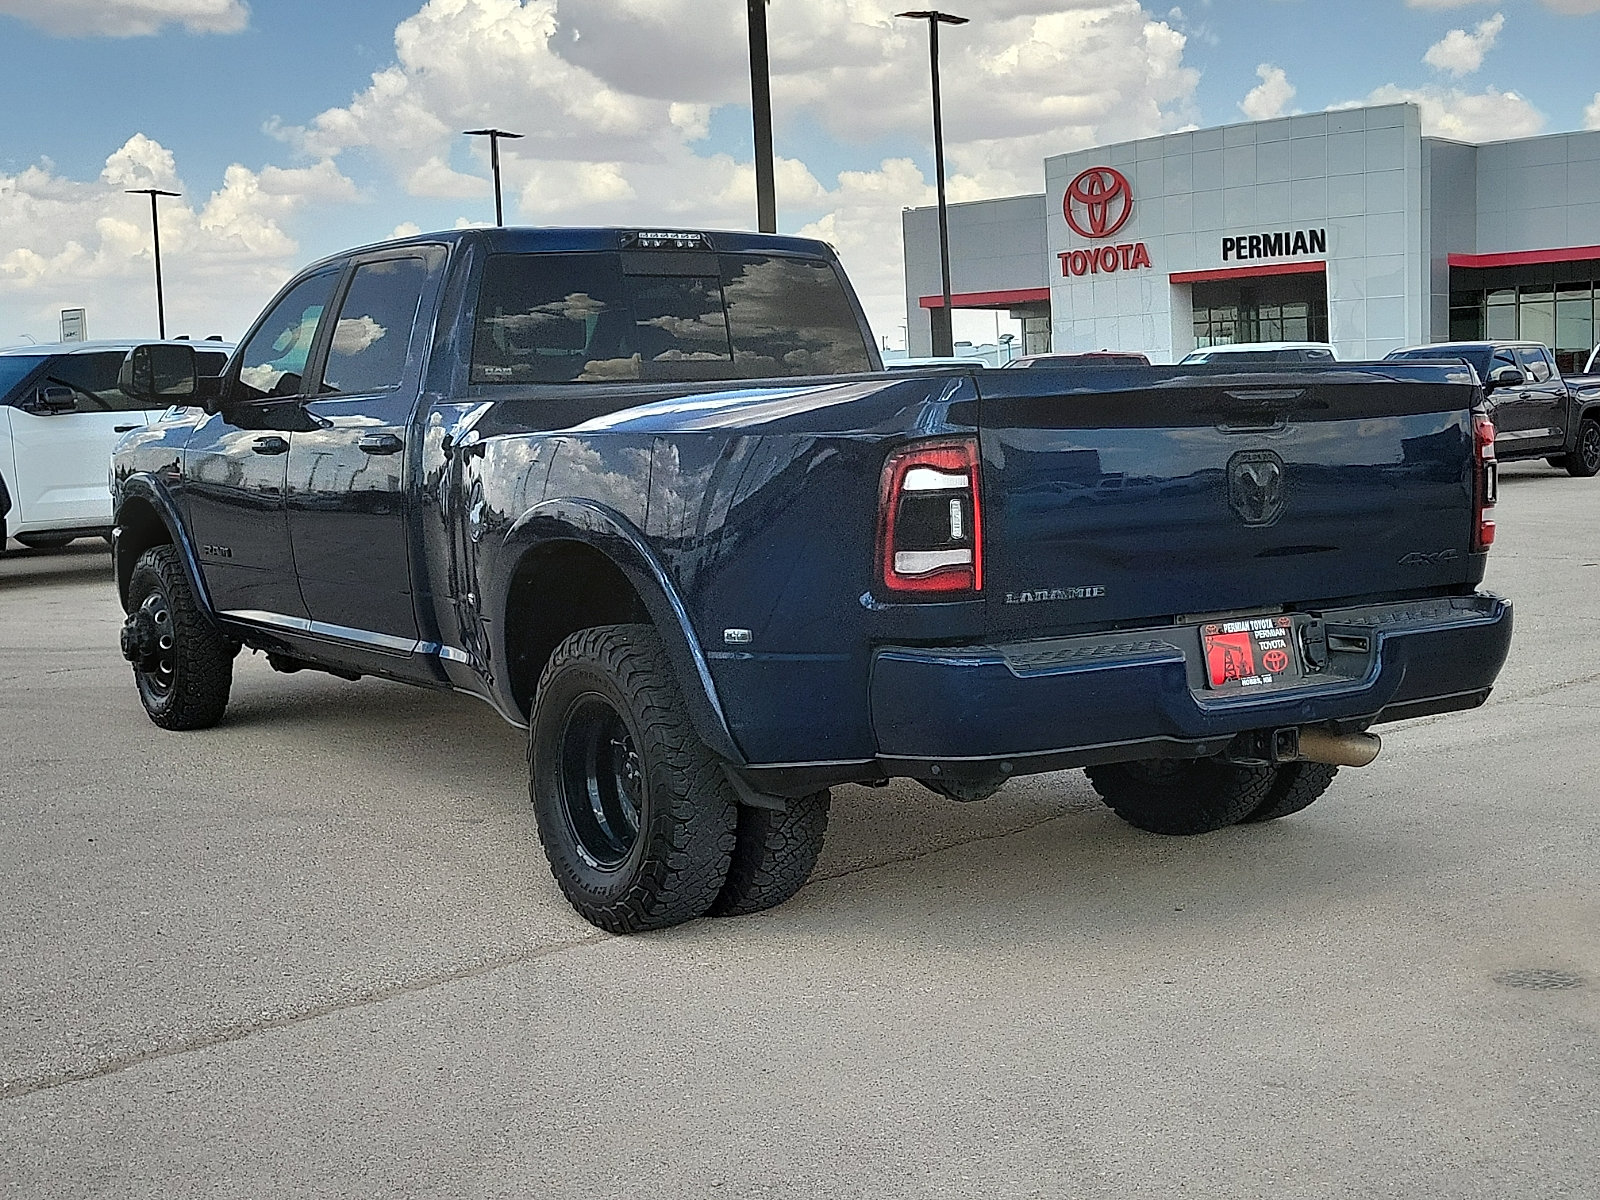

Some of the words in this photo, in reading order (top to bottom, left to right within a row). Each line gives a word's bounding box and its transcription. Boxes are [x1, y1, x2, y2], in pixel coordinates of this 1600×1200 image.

[1222, 228, 1327, 261] PERMIAN
[1057, 242, 1152, 277] TOYOTA
[1006, 586, 1105, 603] LARAMIE
[1223, 620, 1250, 633] PERMIAN
[1250, 618, 1273, 631] TOYOTA
[1254, 628, 1286, 639] PERMIAN
[1258, 639, 1286, 650] TOYOTA
